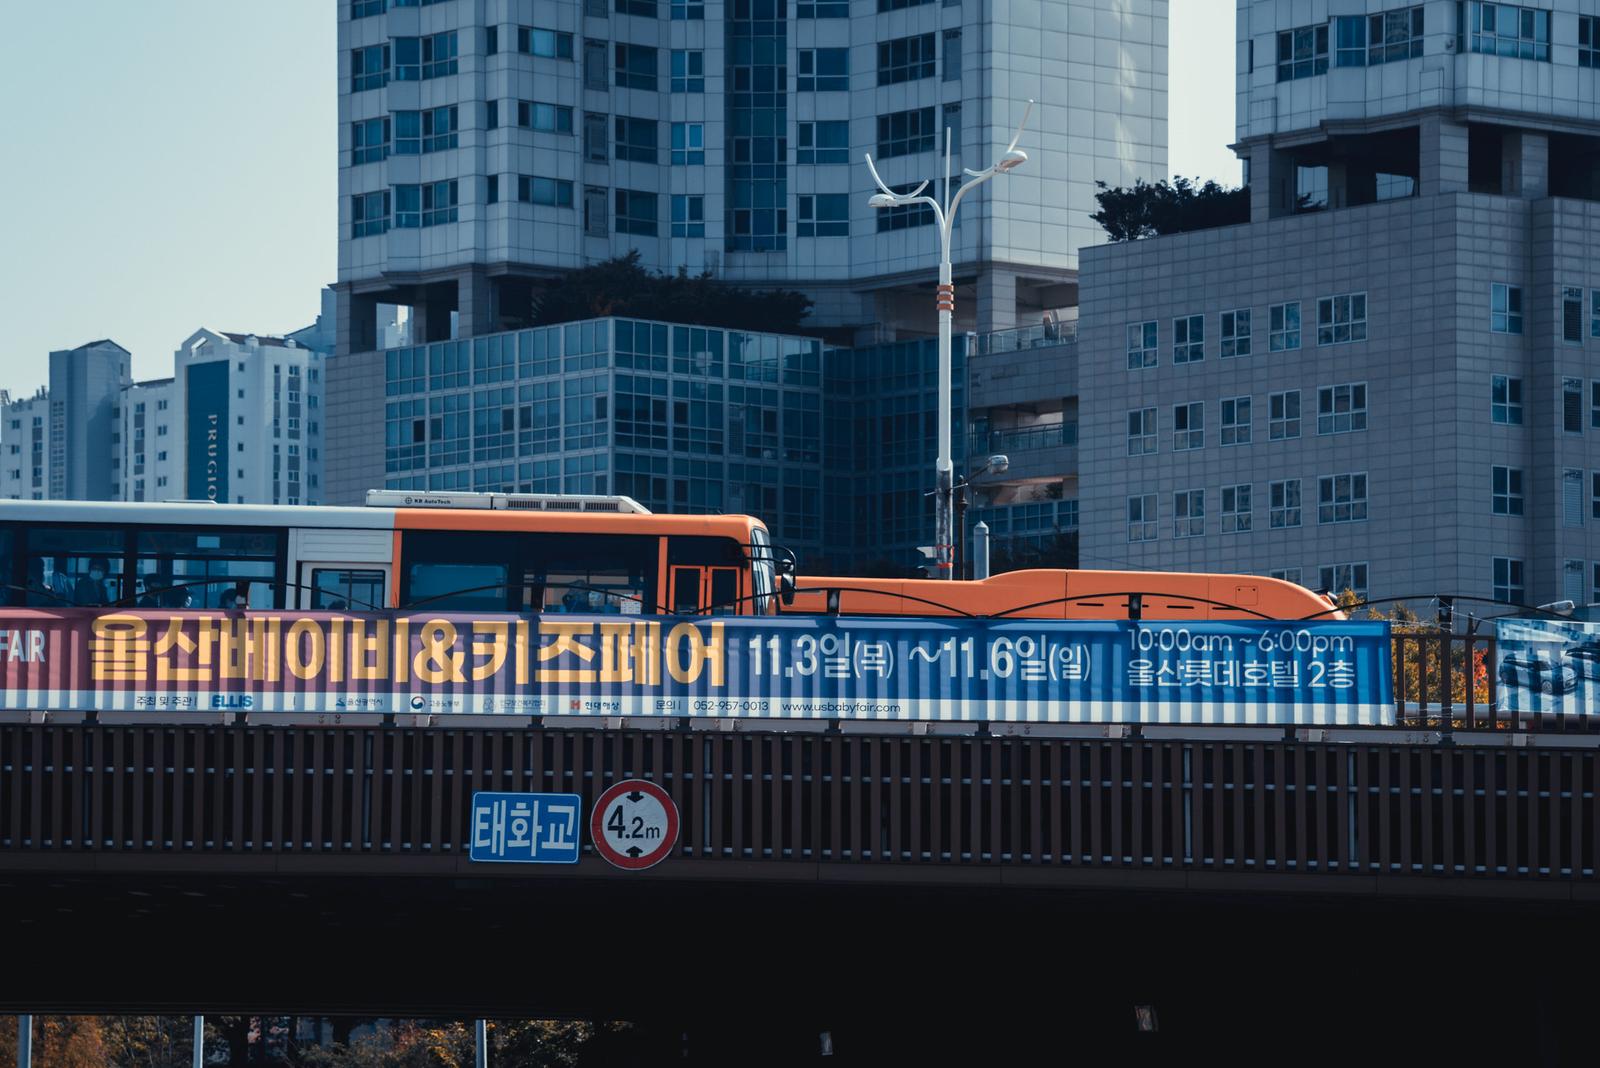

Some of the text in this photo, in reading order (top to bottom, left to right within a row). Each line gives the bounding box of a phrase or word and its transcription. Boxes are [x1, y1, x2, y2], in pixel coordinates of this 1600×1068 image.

[207, 414, 217, 499] PRUGIO
[0, 629, 46, 662] FAIR
[88, 613, 725, 687] 울산베이비&키즈페어
[1127, 628, 1233, 652] 10:00am
[1257, 629, 1354, 658] 6:00pm
[1127, 658, 1355, 689] 울산롯데호텔 2층
[136, 695, 156, 706] 주최
[159, 696, 169, 706] 및
[211, 694, 254, 708] ELLIS
[656, 700, 901, 714] 문의 052-957-0013 www.usbabyfair.com
[474, 800, 576, 857] 태화교
[607, 804, 660, 840] 4.2m
